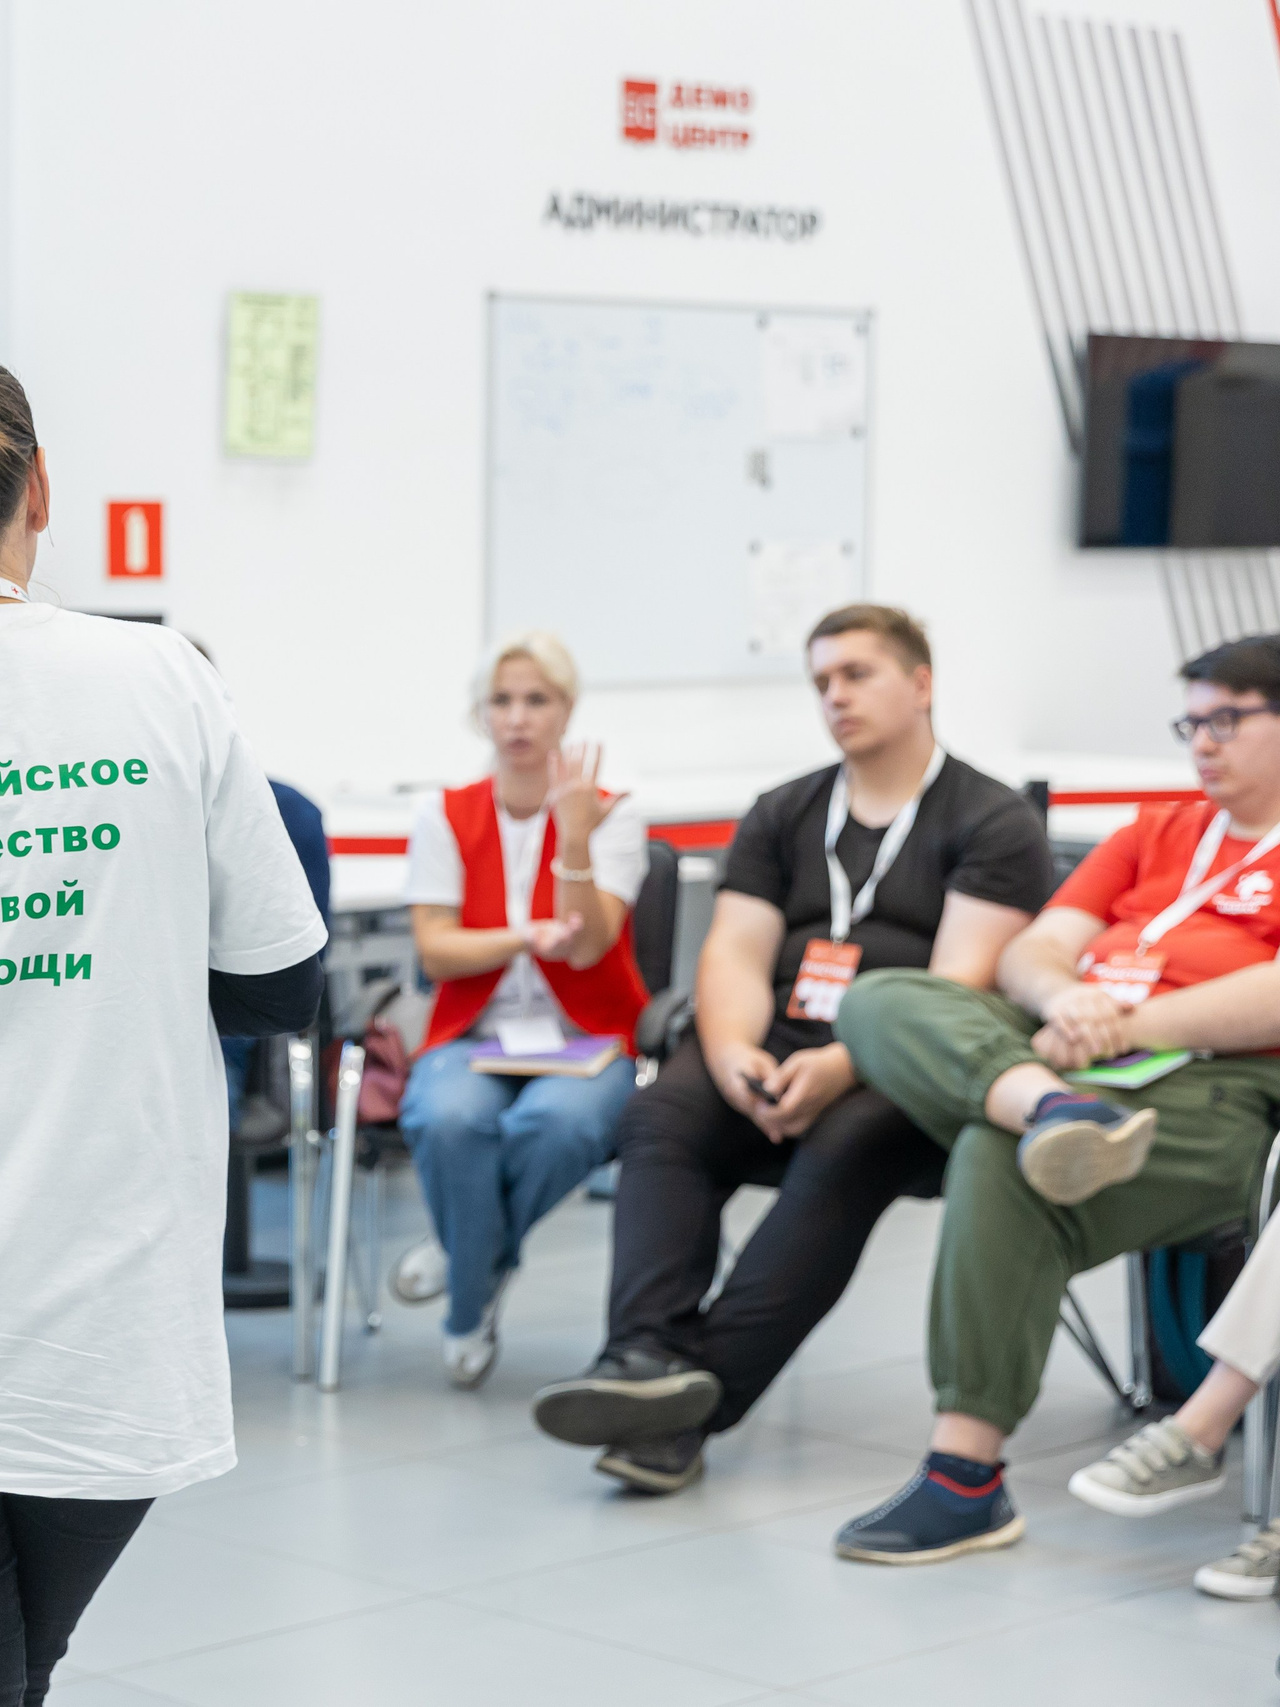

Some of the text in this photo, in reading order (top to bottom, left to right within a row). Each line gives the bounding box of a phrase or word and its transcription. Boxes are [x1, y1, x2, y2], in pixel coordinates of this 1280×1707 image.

[670, 84, 752, 111] ДЕМО
[671, 123, 751, 150] ЦЕНТР
[543, 191, 822, 243] АДМИНИСТРАТОР
